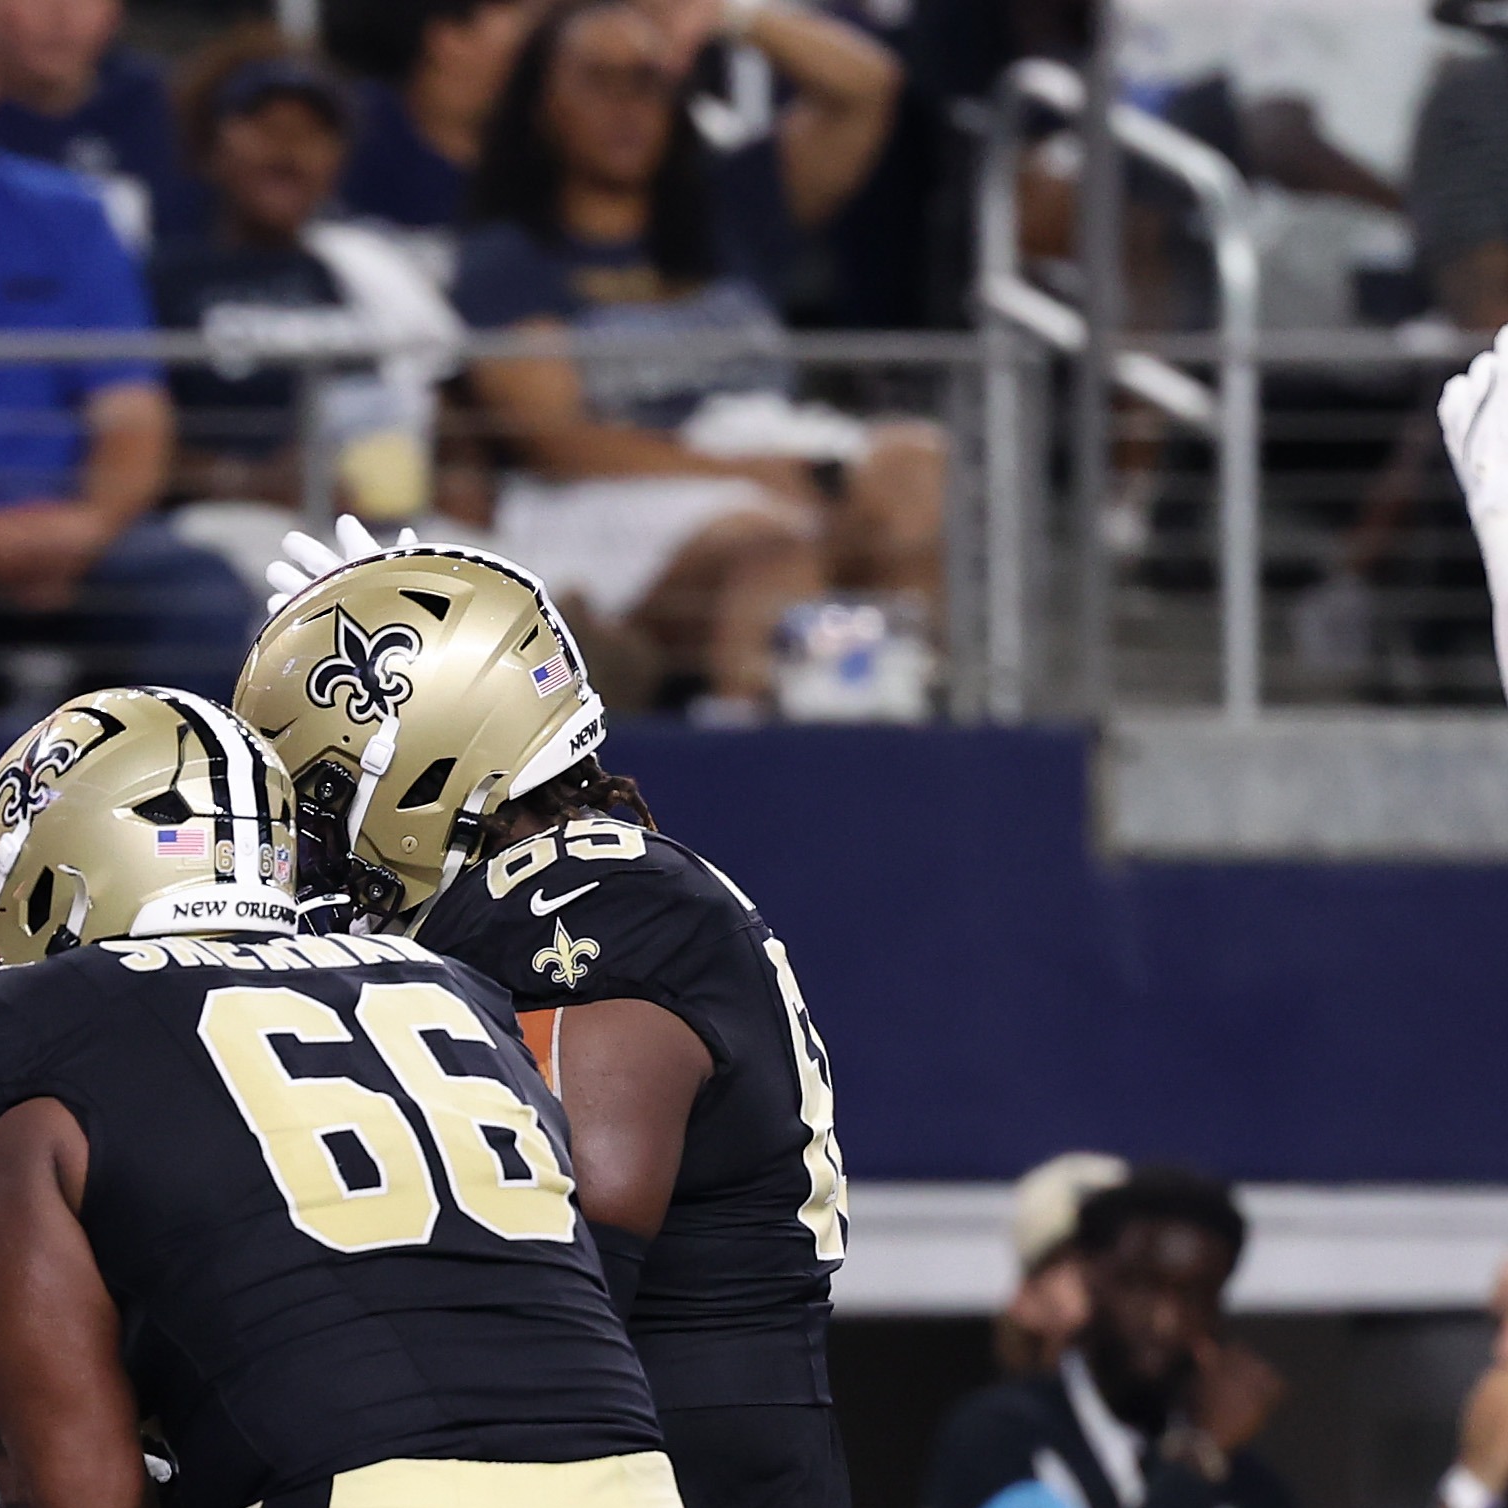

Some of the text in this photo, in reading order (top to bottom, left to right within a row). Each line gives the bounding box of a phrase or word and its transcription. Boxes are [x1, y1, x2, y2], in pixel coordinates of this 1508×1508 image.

[569, 718, 598, 757] NEW
[486, 818, 646, 899] 65
[172, 900, 228, 920] NEW
[196, 982, 577, 1255] 66
